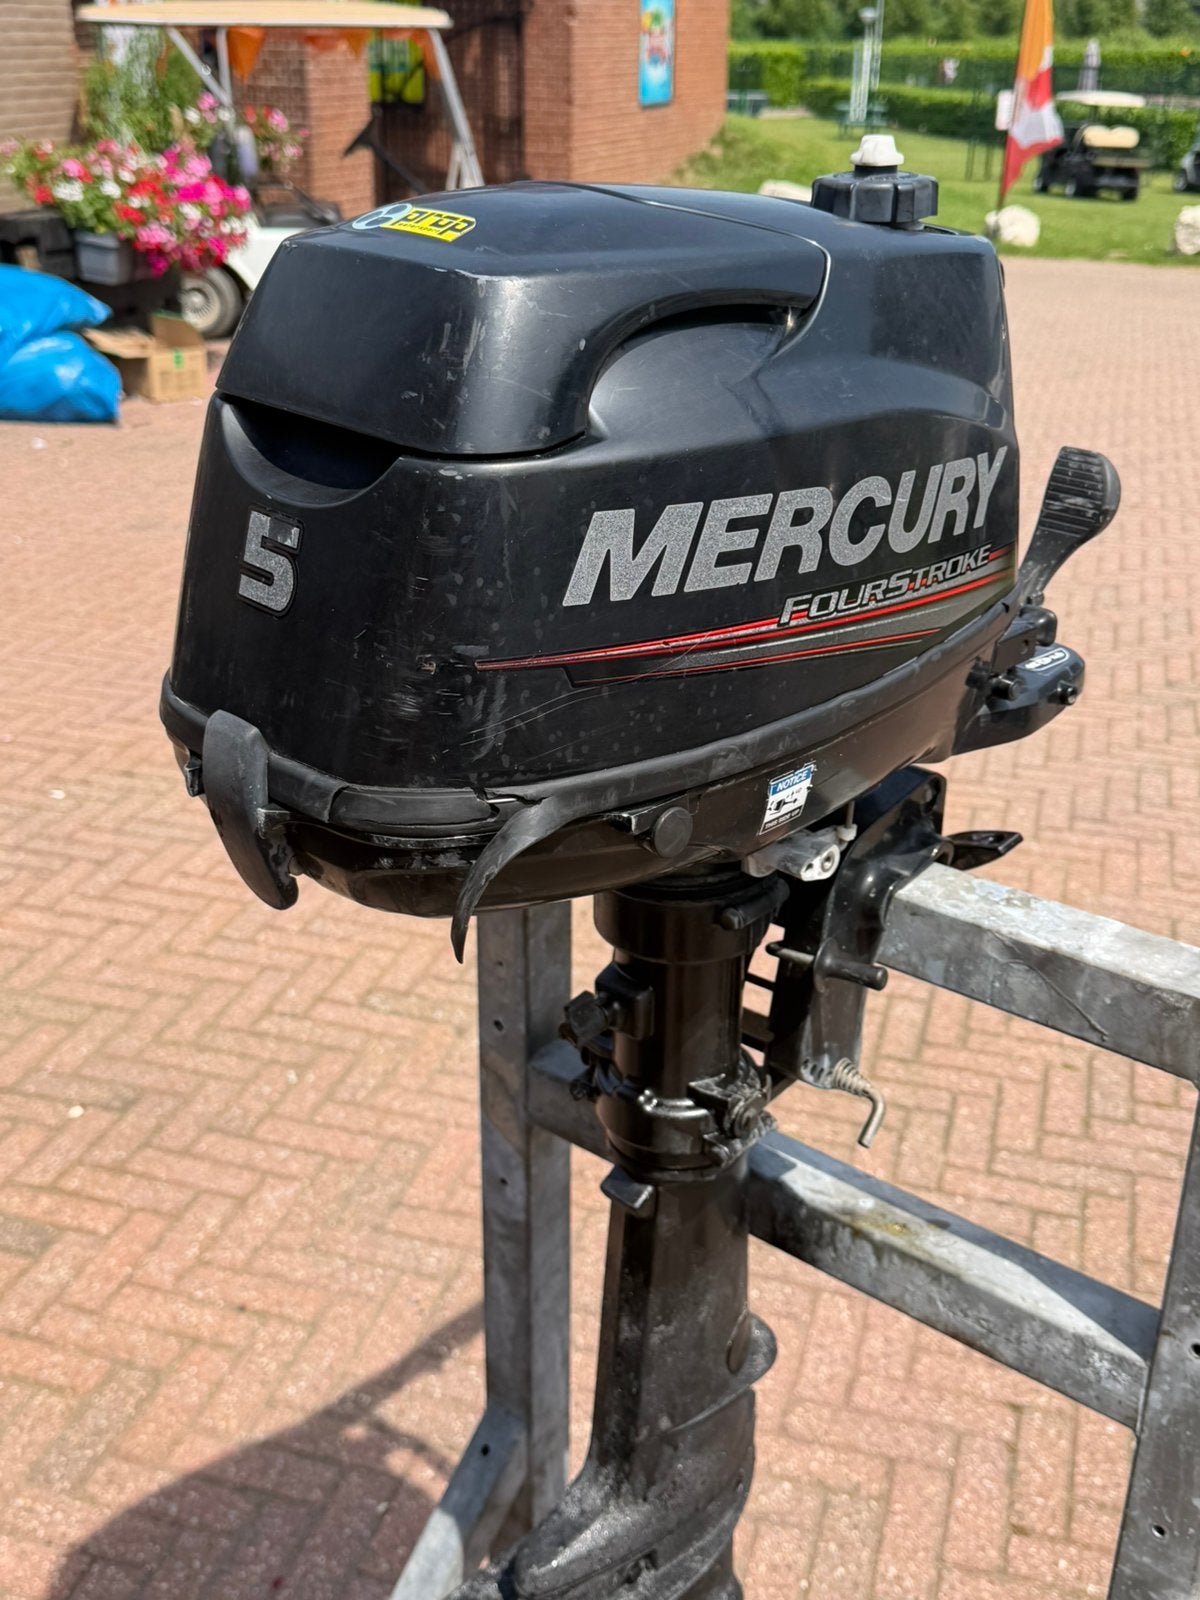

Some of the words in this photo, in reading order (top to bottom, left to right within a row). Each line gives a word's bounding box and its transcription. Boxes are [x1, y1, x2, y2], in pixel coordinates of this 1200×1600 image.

[238, 509, 301, 612] 5
[562, 446, 1008, 606] MERCURY
[778, 545, 993, 626] FOURSTROKE
[776, 769, 808, 792] NOTICE
